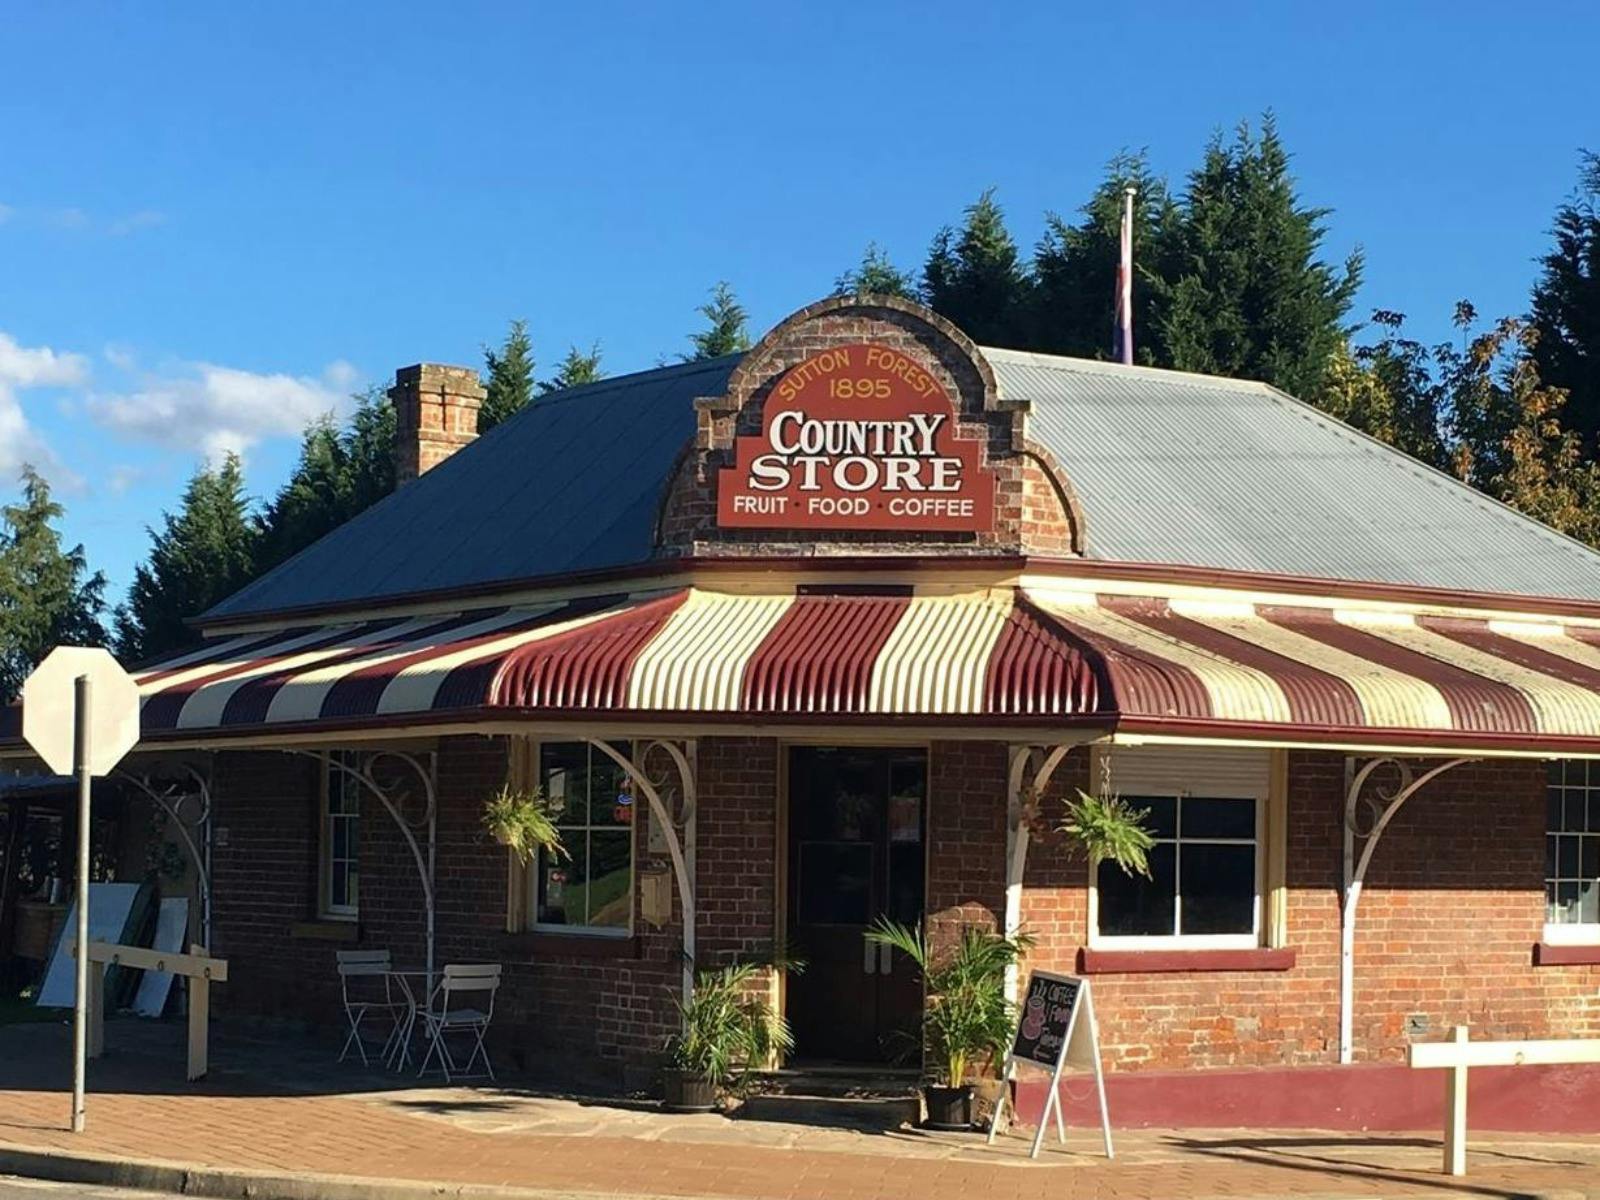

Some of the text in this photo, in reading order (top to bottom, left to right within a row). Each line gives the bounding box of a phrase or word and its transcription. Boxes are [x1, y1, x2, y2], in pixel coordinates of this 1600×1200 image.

[778, 349, 940, 401] SUTTON FOREST
[830, 378, 892, 398] 1895
[769, 411, 946, 455] COUNTRY
[749, 455, 963, 491] STORE
[733, 496, 974, 517] FRUIT FOOD COFFEE
